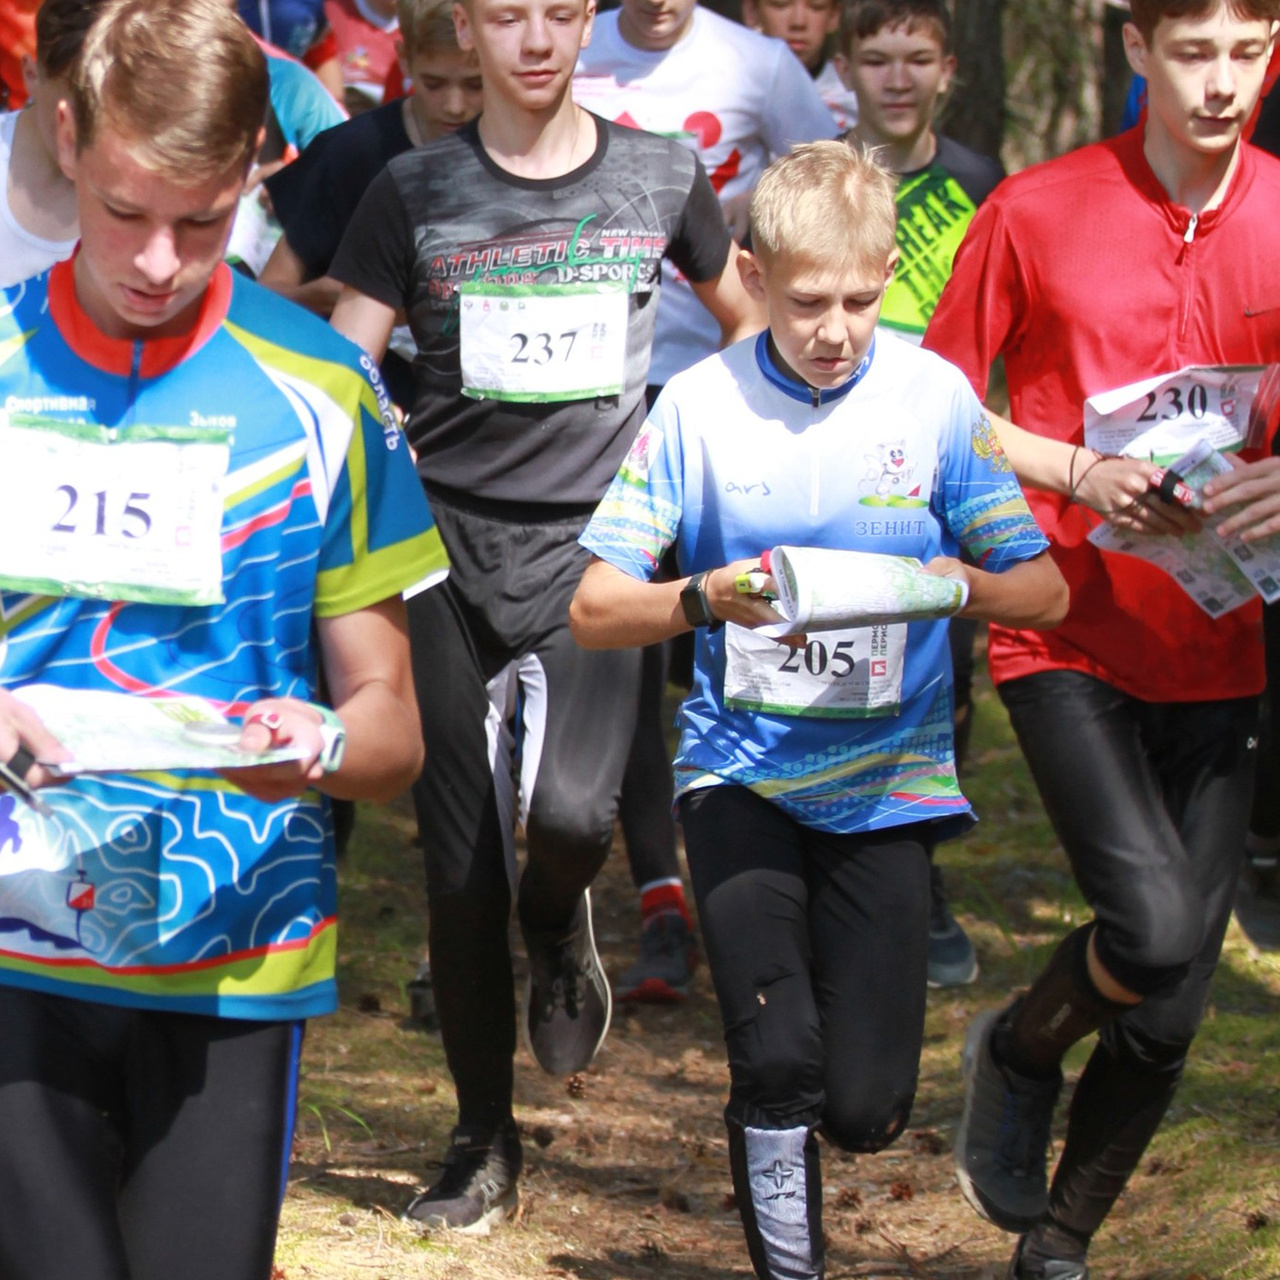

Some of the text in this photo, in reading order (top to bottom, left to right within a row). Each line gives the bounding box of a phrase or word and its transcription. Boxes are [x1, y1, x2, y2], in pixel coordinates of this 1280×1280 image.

[426, 237, 667, 278] ATHLETIC TIME
[510, 332, 578, 365] 237
[5, 396, 96, 413] Спортивная
[1137, 384, 1208, 422] 230
[51, 484, 152, 539] 215
[855, 520, 926, 536] ЗЕНИТ
[777, 640, 855, 678] 205
